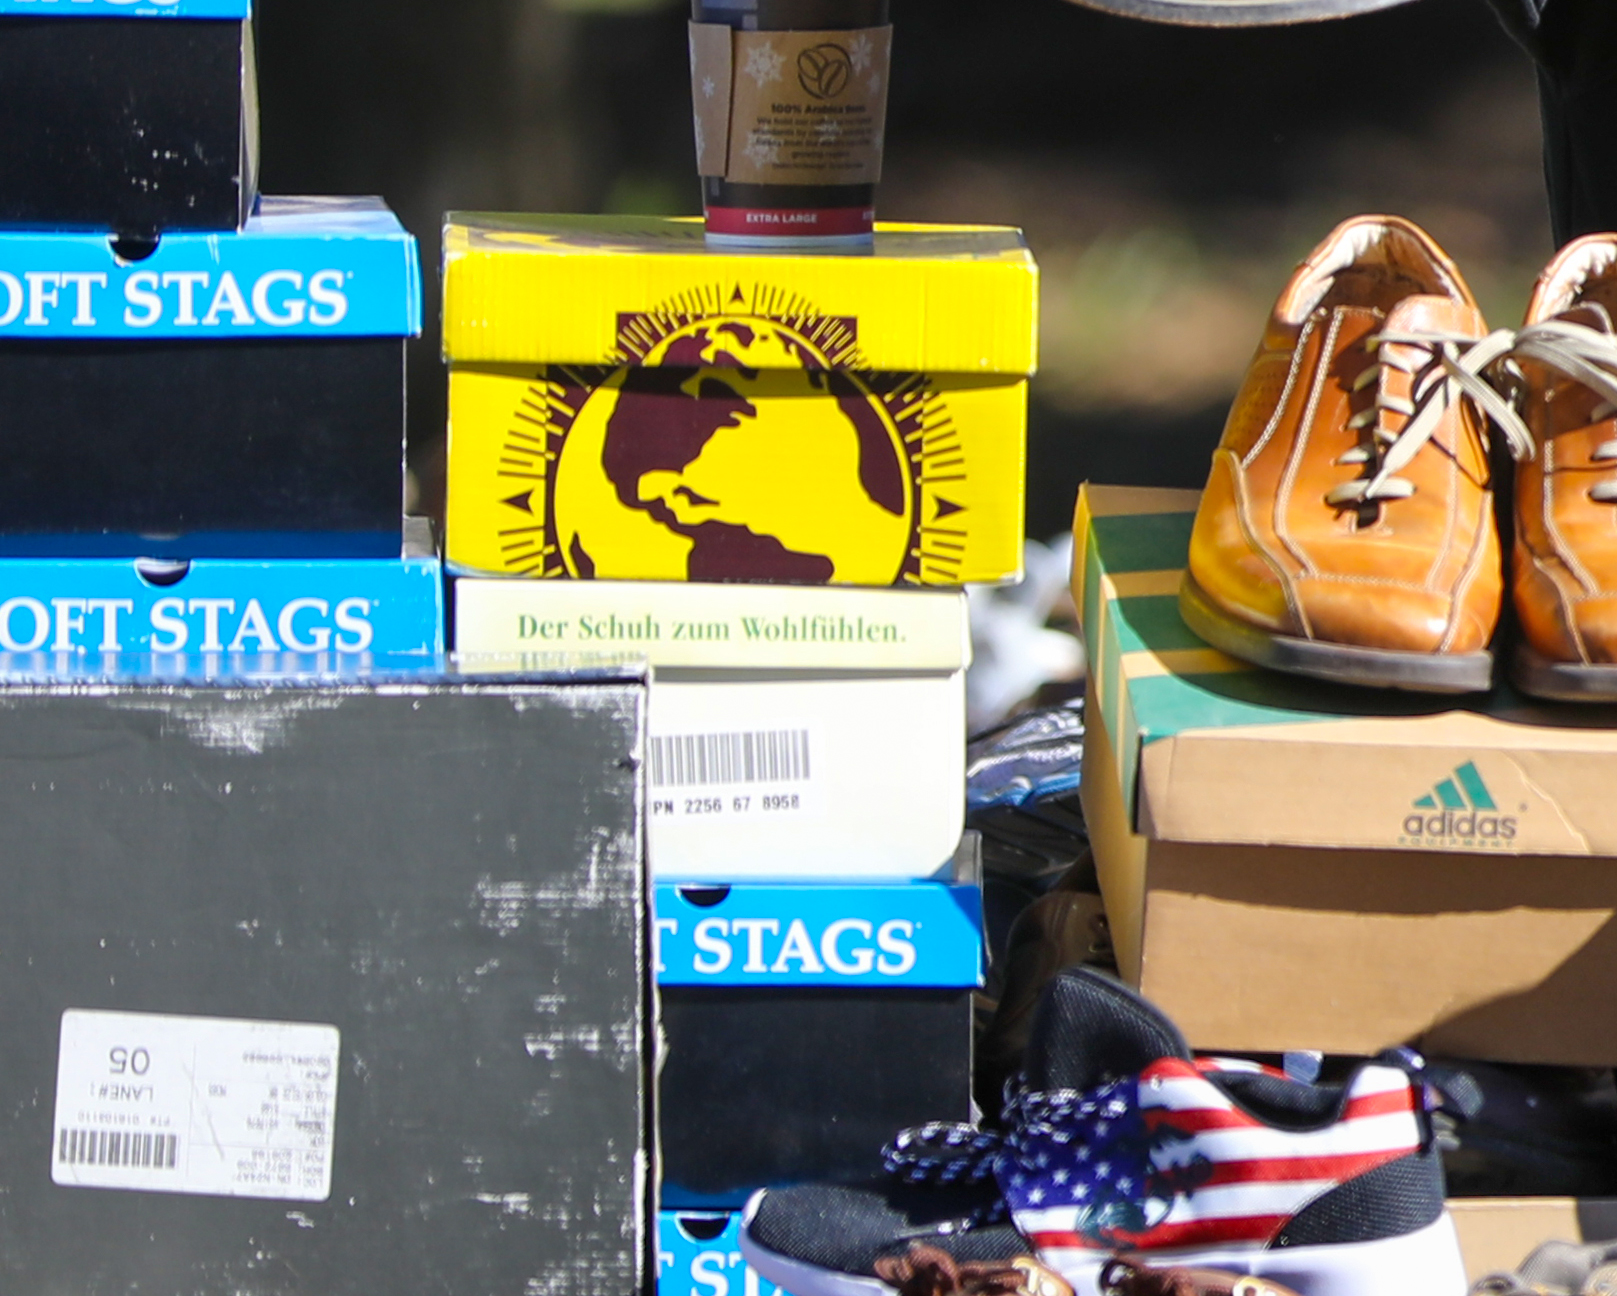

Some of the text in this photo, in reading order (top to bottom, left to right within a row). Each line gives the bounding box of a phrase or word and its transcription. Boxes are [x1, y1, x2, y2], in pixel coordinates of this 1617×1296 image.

[745, 212, 818, 224] EXTRA LARGE
[123, 268, 349, 328] STAGS
[150, 596, 374, 653] STAGS
[517, 611, 907, 644] Der Schuh zum Wohlfühlen.
[653, 800, 674, 815] PN
[684, 798, 722, 814] 2256
[732, 796, 751, 812] 67
[1402, 809, 1518, 840] adidas
[692, 918, 917, 976] STAGS
[108, 1046, 150, 1077] 05
